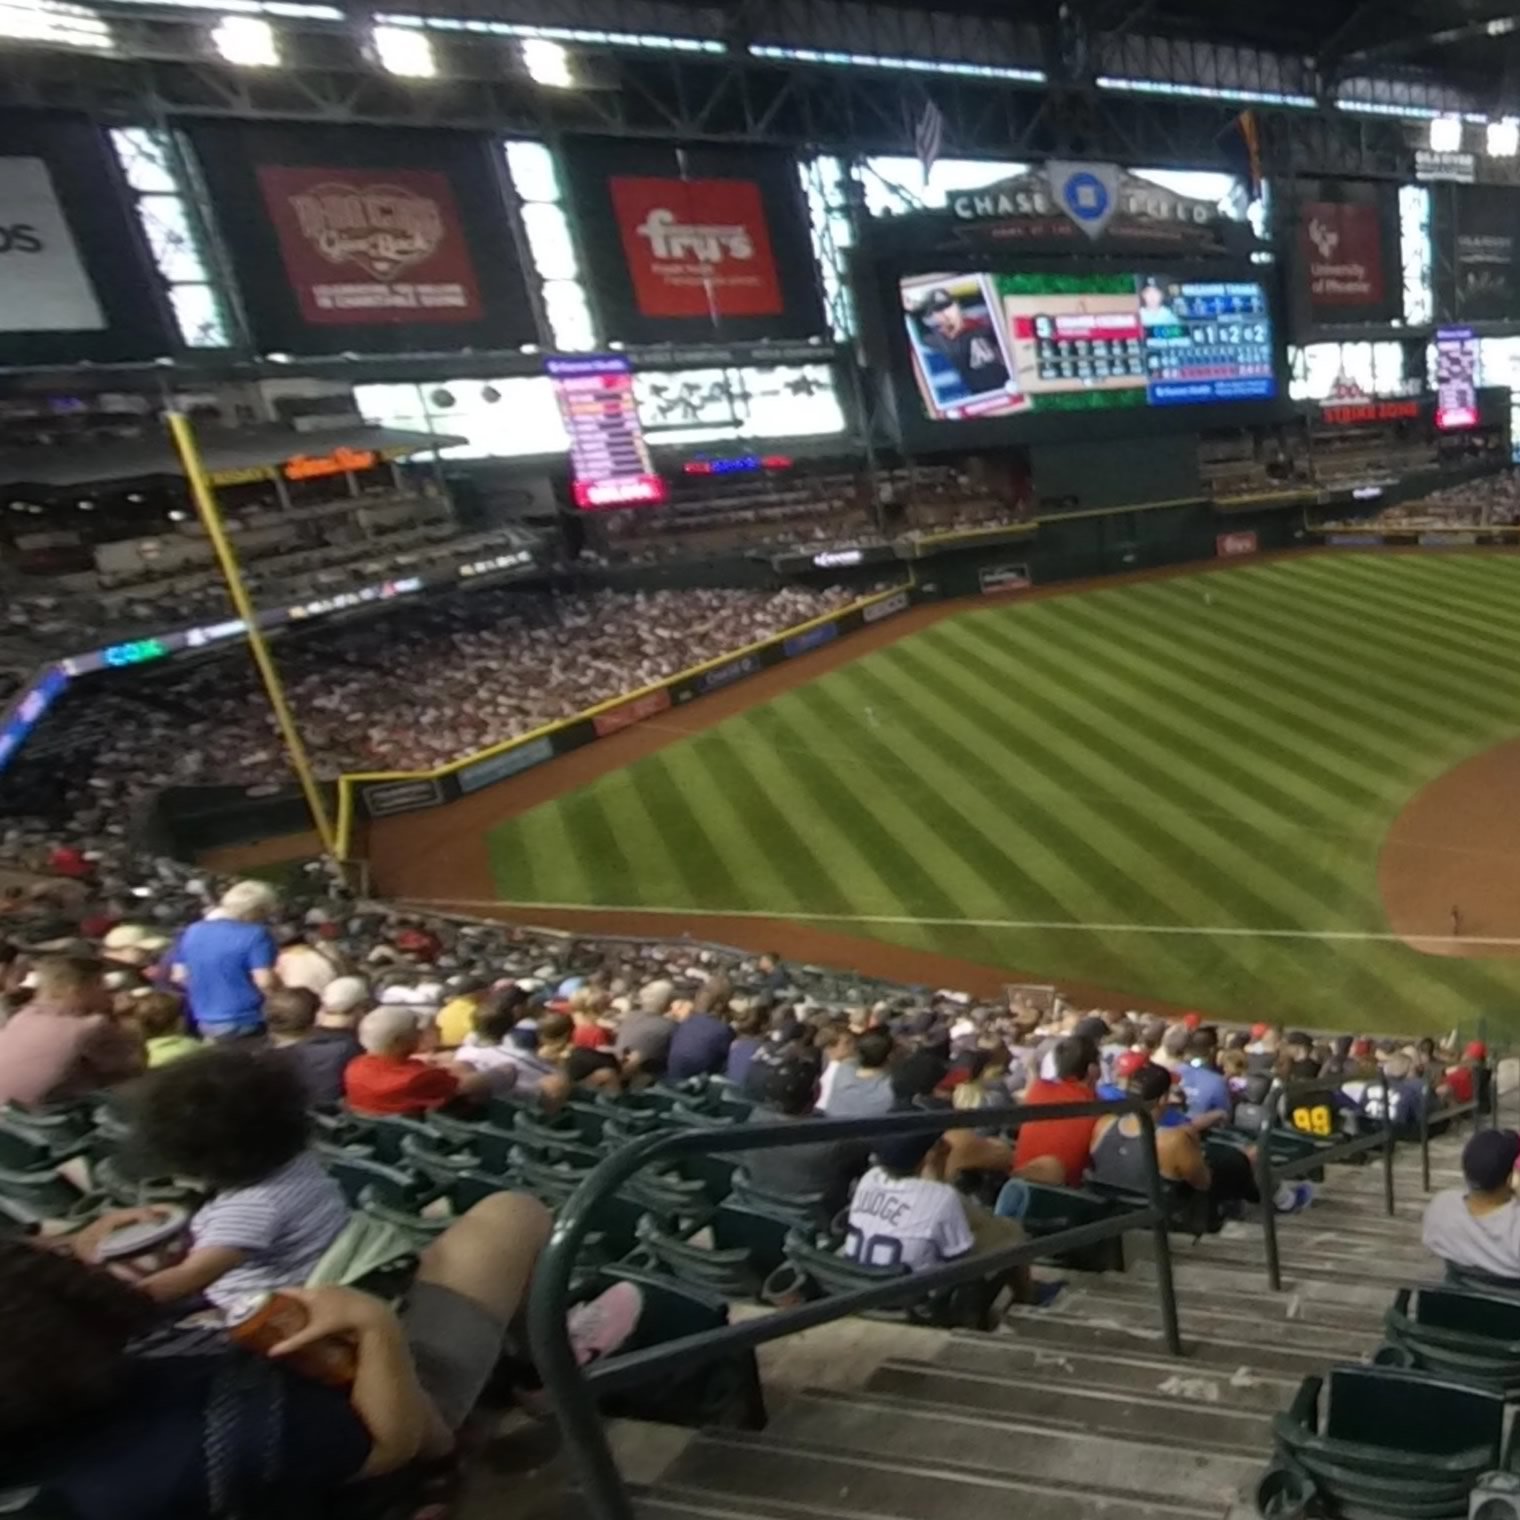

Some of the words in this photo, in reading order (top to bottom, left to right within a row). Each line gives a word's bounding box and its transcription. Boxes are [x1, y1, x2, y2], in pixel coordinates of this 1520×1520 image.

[954, 191, 1048, 219] CHASE
[1128, 193, 1208, 223] FIELD
[636, 208, 754, 263] fry's
[1311, 263, 1366, 281] University
[104, 638, 164, 667] COX
[1293, 1104, 1332, 1137] 99
